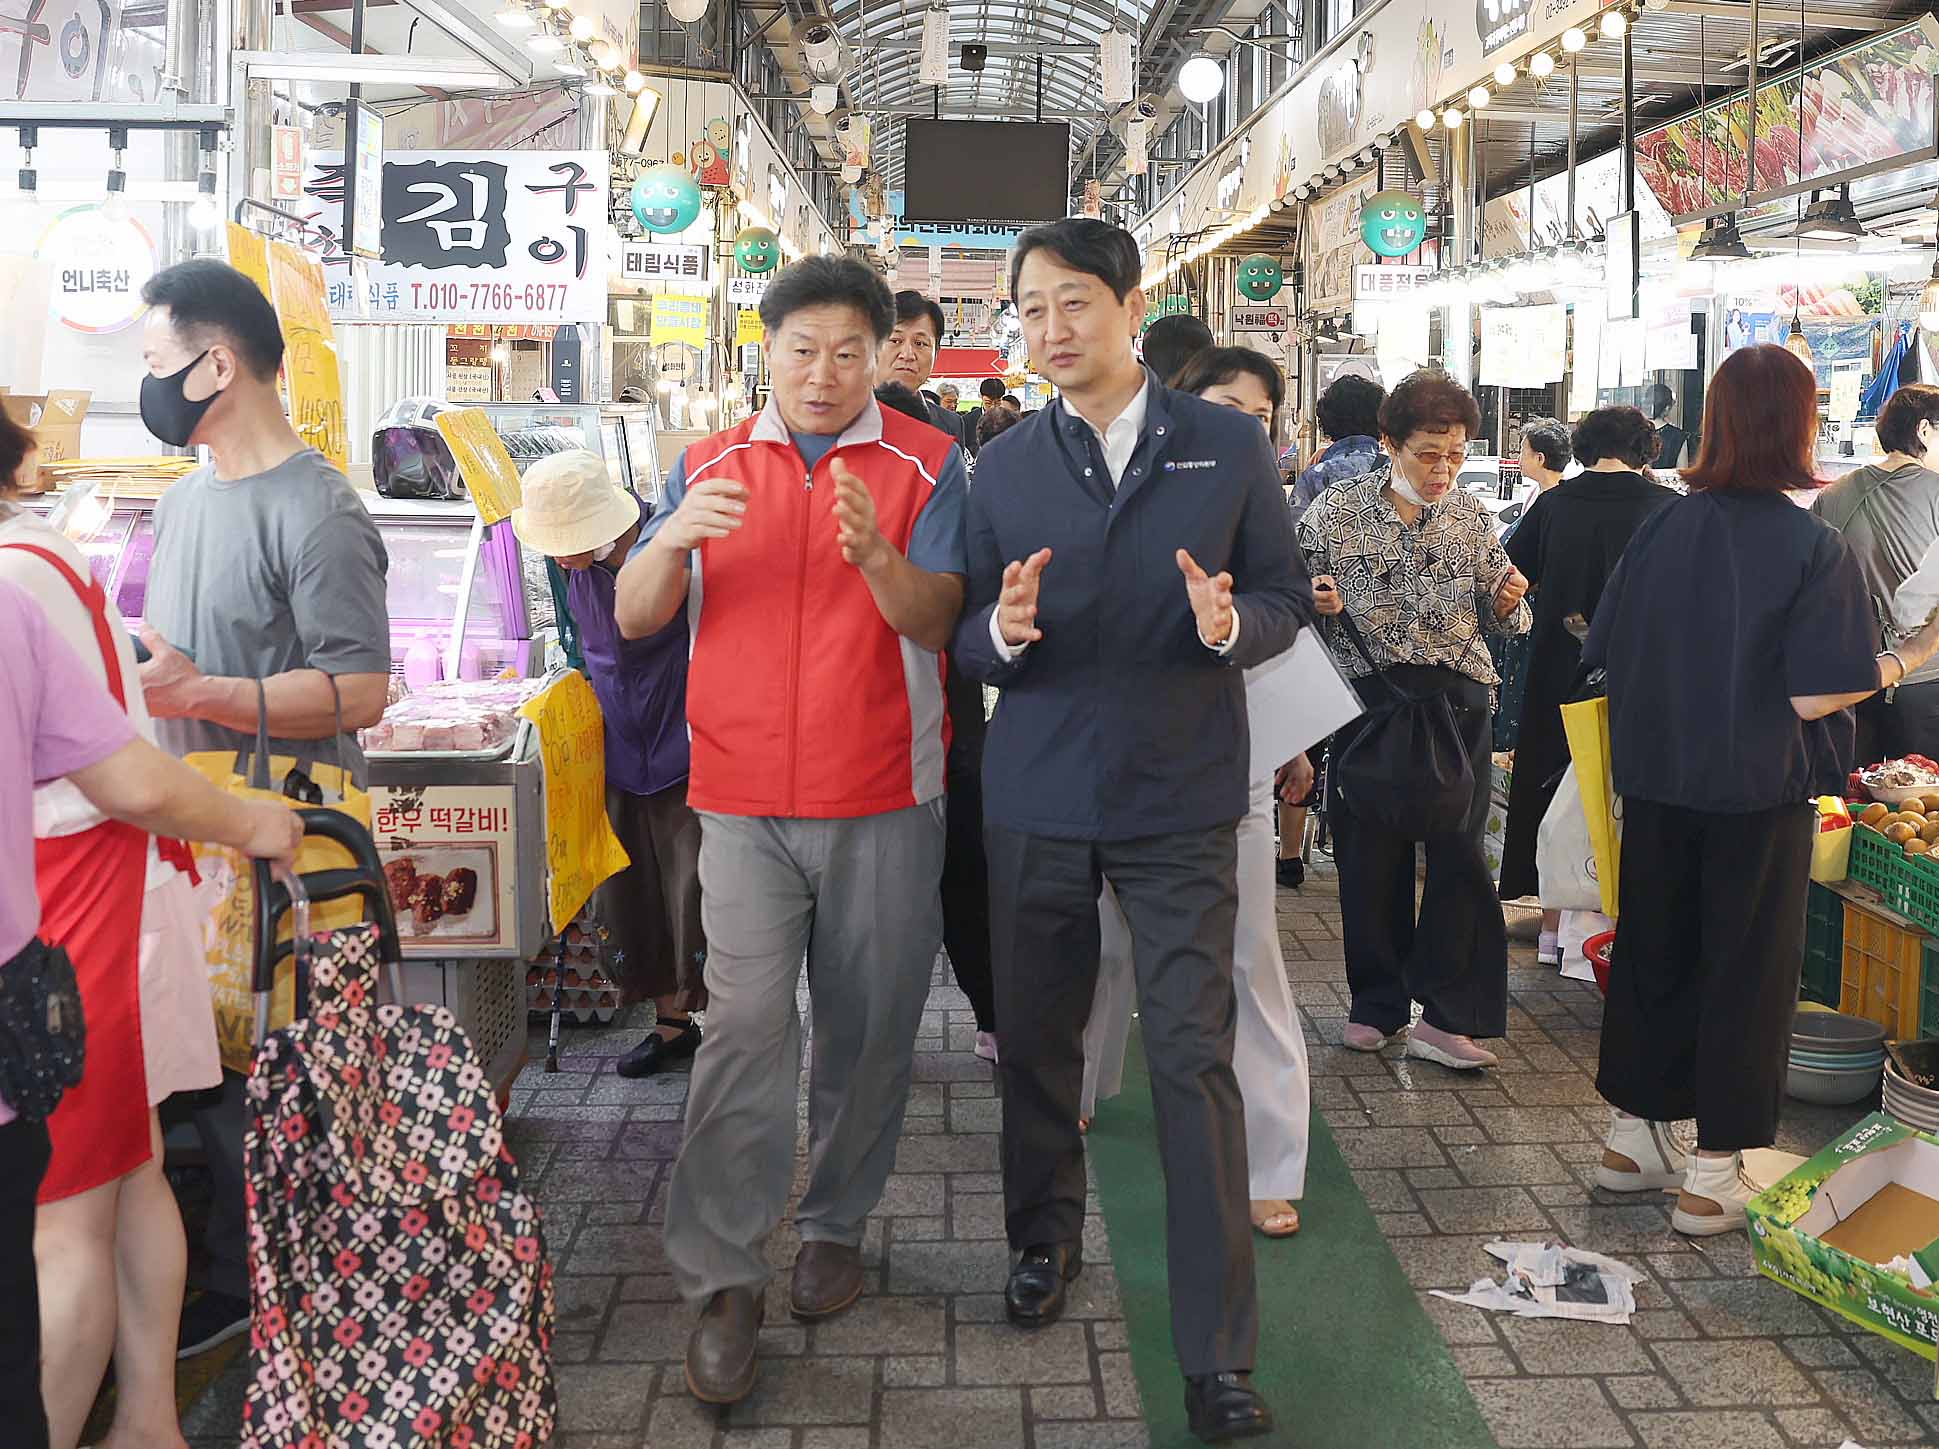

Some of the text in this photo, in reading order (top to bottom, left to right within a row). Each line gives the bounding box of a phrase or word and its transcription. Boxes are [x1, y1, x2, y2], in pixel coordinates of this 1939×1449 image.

[395, 172, 490, 252] 김
[626, 252, 699, 276] 태림식품
[62, 269, 131, 293] 언니축산
[328, 281, 569, 311] 태식품 T.010-7766-6877
[377, 807, 508, 833] 한우 떡갈비!
